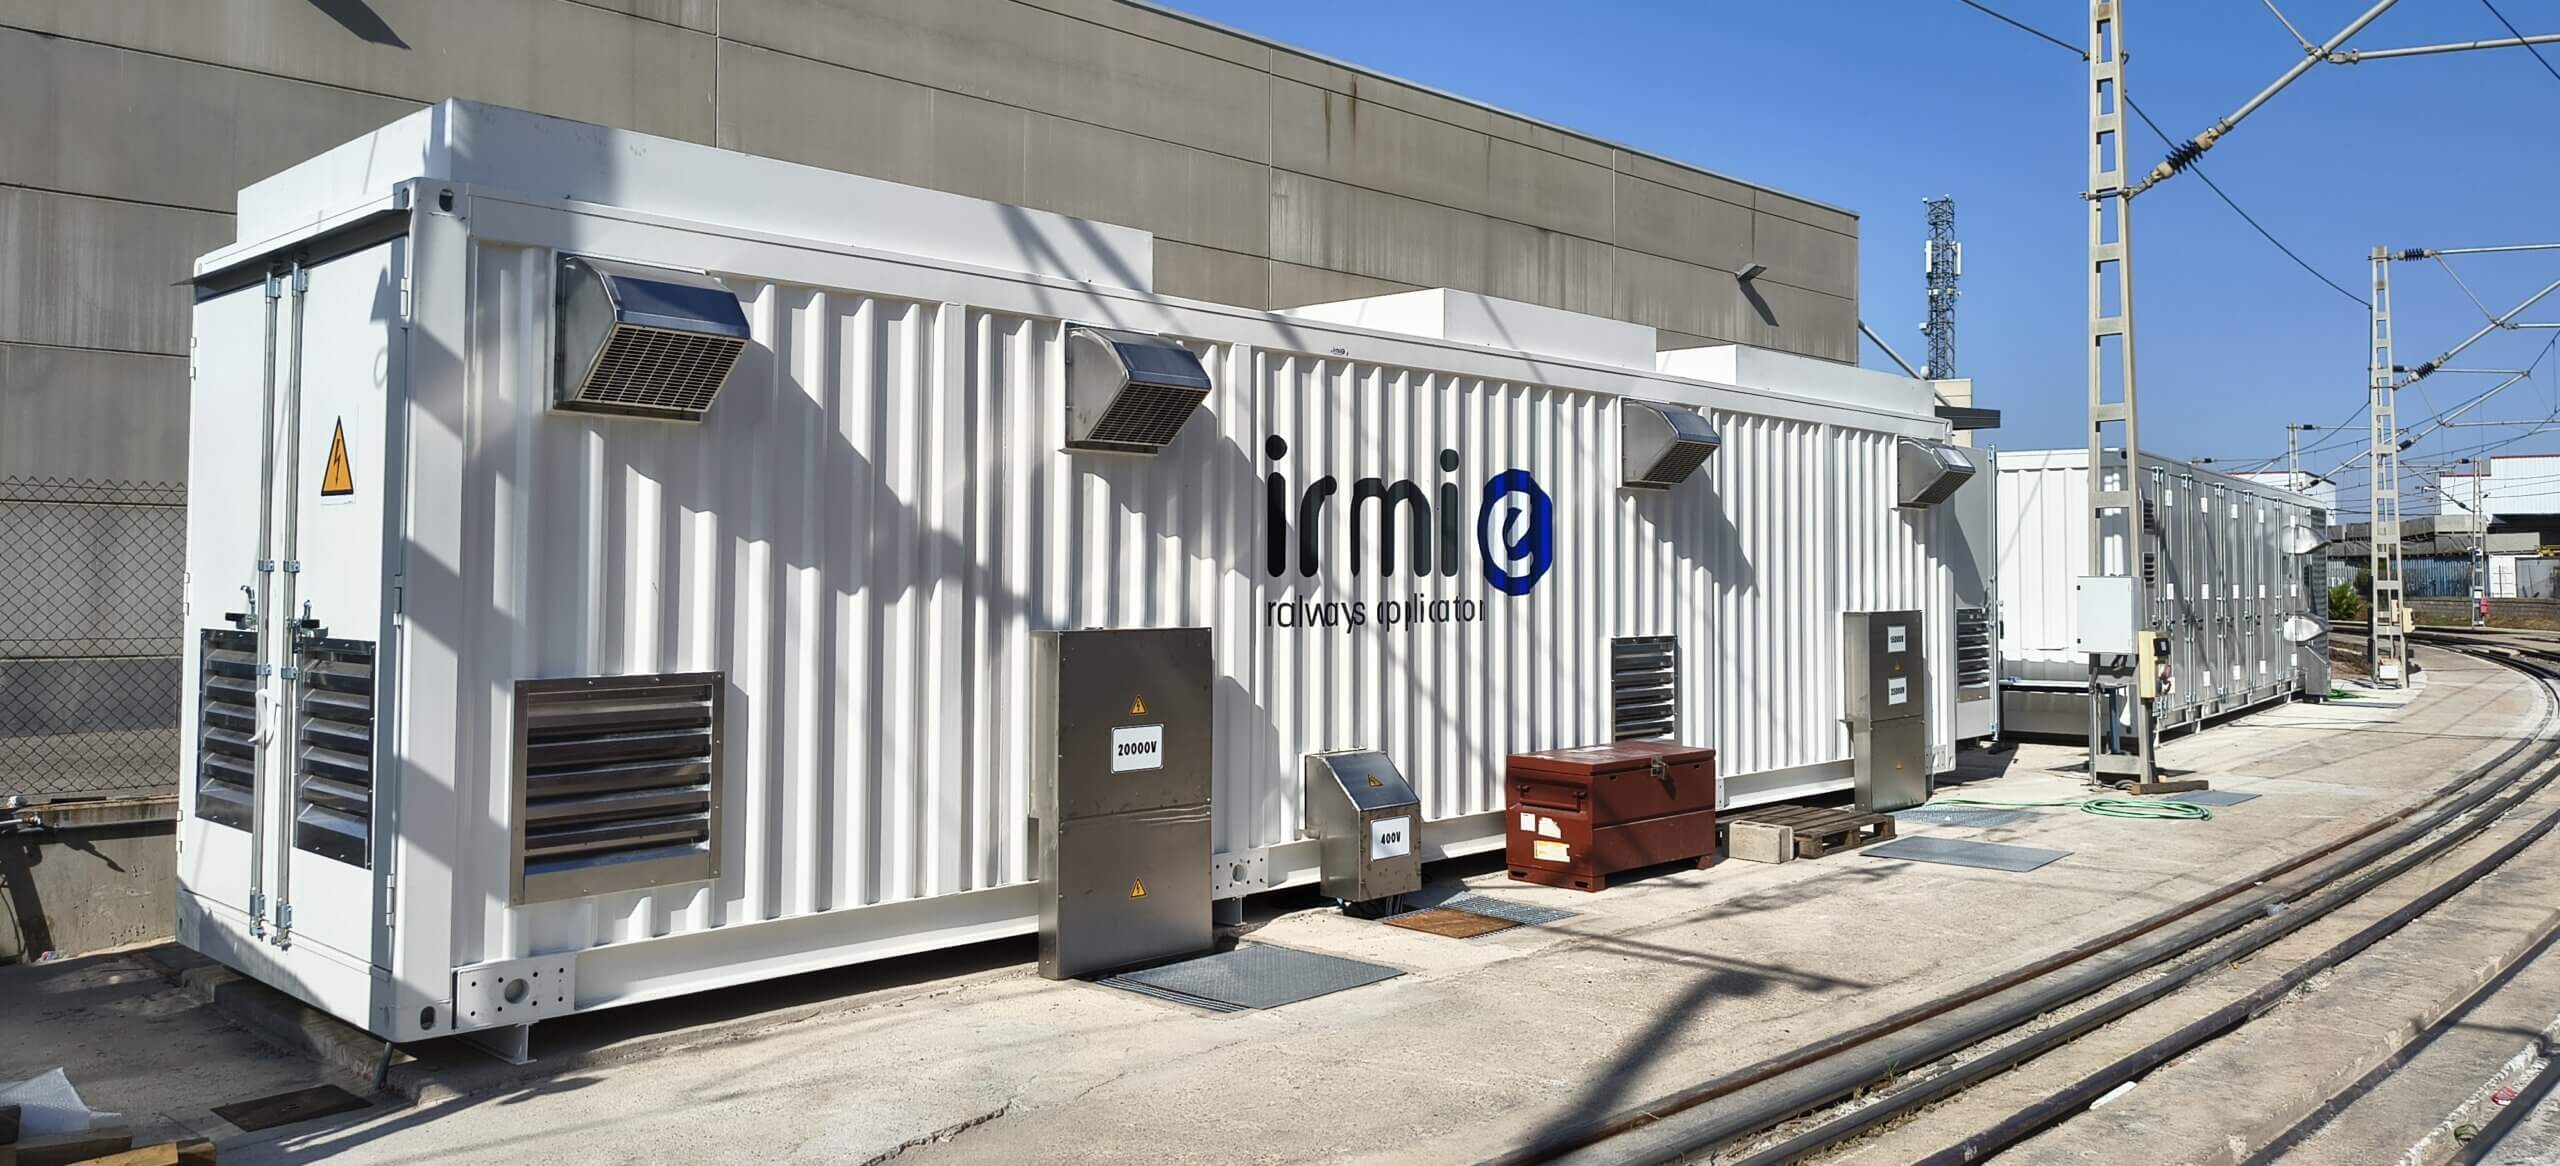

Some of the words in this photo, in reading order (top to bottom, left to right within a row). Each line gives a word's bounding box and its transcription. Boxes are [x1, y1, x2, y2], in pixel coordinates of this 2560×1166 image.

[1268, 595, 1365, 634] ralways
[1118, 740, 1157, 757] 20000V
[1381, 831, 1401, 845] 400V
